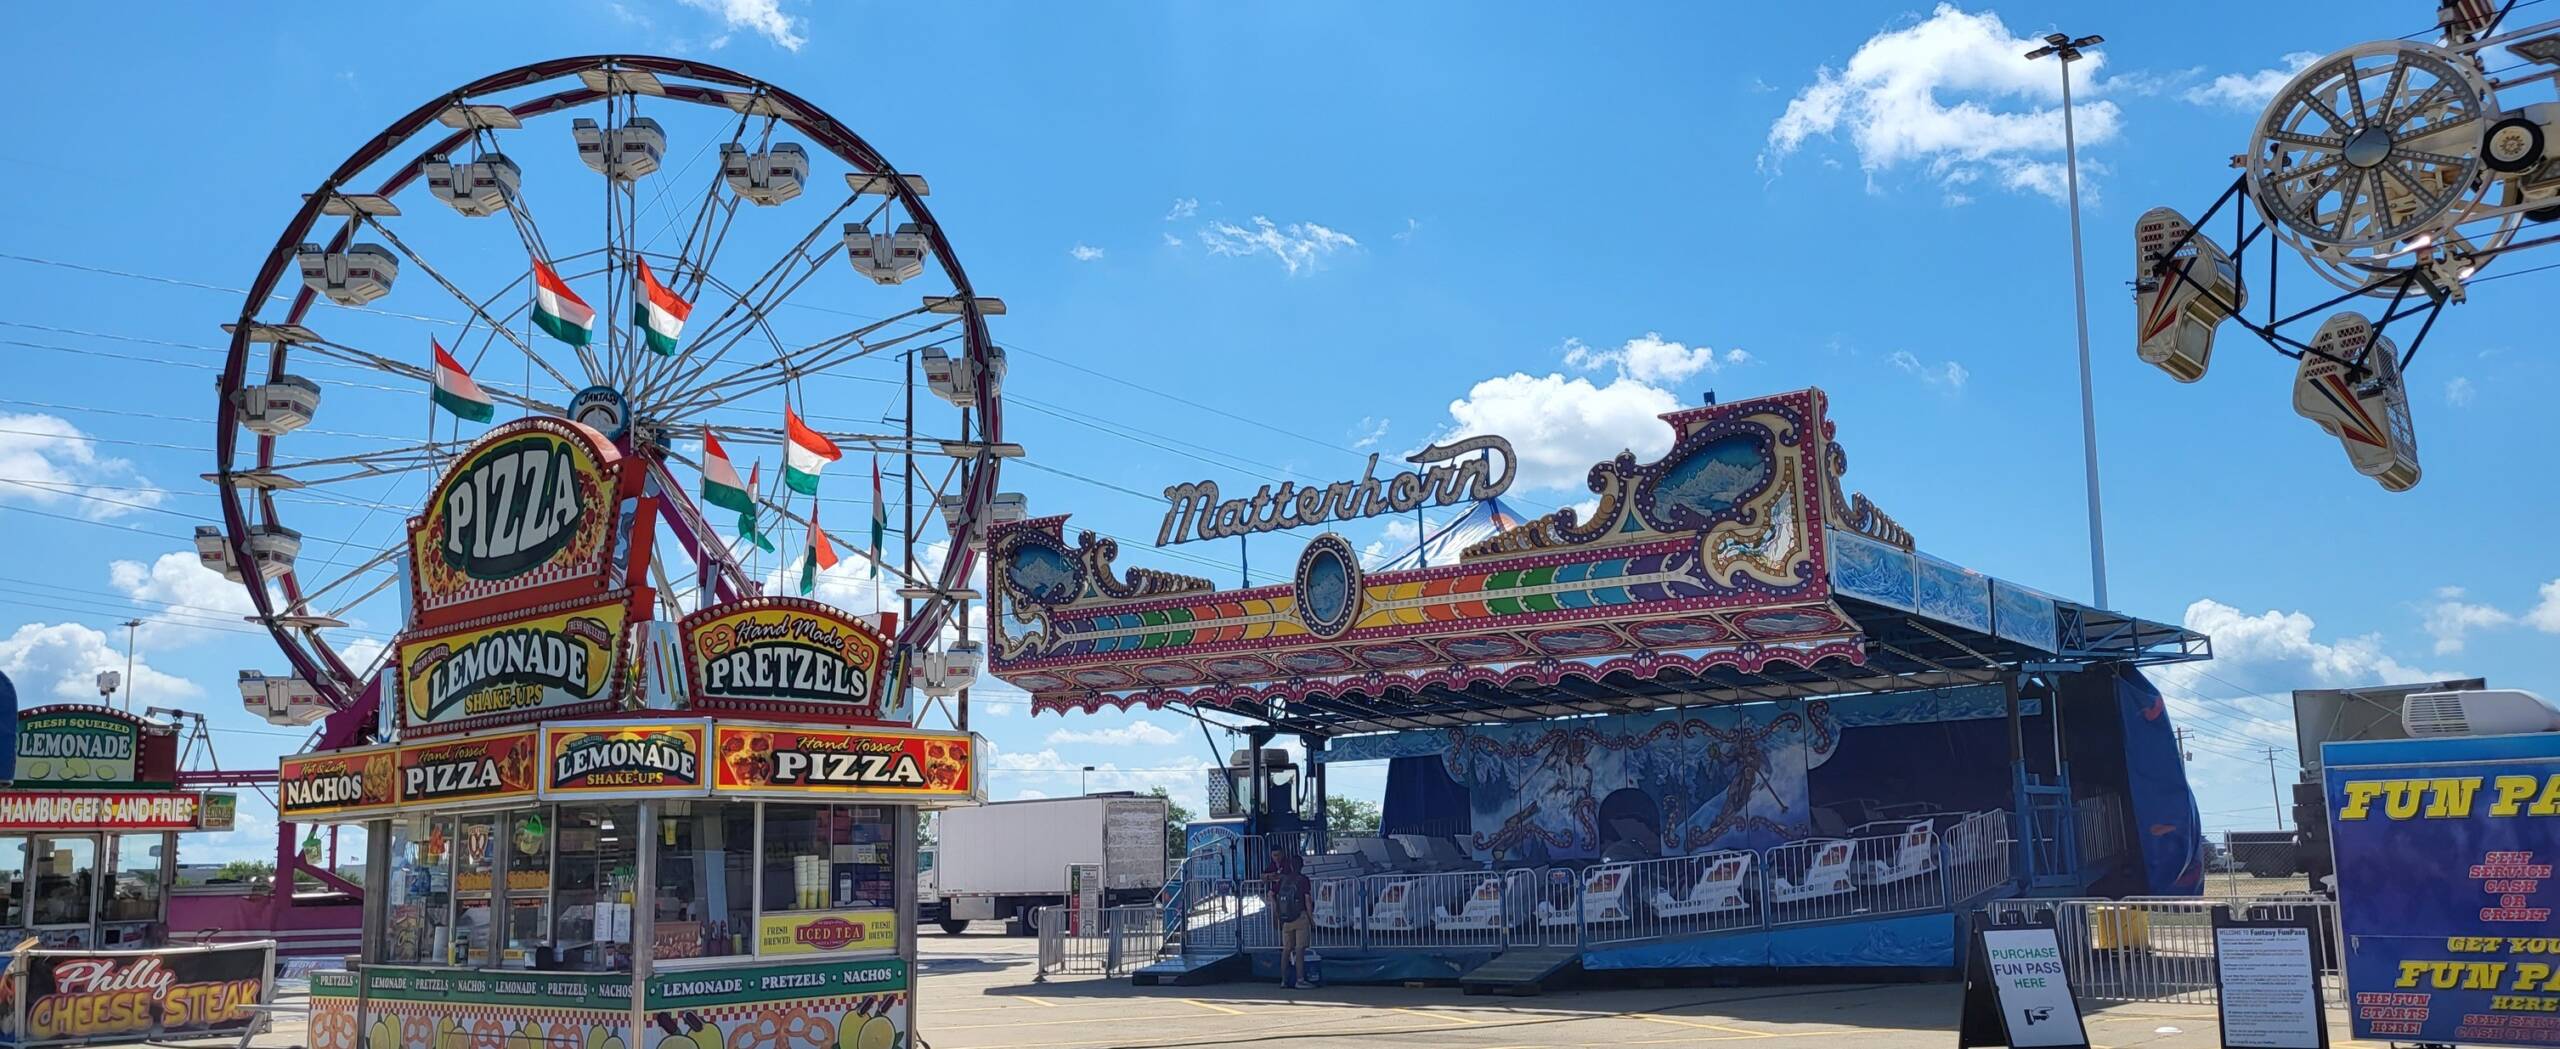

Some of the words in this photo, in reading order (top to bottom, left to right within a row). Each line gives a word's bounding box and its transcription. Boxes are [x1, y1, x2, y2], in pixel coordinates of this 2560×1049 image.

[433, 153, 446, 161] 10
[1155, 434, 1517, 548] Matterhorn
[449, 450, 579, 558] PIZZA
[735, 615, 790, 643] Hand
[791, 617, 846, 650] Made
[431, 634, 586, 710] LEMONADE
[712, 646, 867, 698] PRETZELS
[465, 683, 544, 714] SHAKE-UPS
[27, 719, 66, 731] FRESH
[69, 718, 130, 733] SQUEEZED
[20, 733, 131, 759] LEMONADE
[796, 736, 851, 751] Hand
[855, 738, 904, 752] Tossed
[418, 747, 452, 763] Hand
[452, 743, 489, 758] Tossed
[558, 743, 695, 781] LEMONADE
[775, 752, 923, 784] PIZZA
[406, 759, 502, 795] PIZZA
[586, 772, 664, 785] SHAKE-UPS
[286, 774, 362, 806] NACHOS
[2340, 776, 2484, 820] FUN
[0, 796, 112, 823] HAMBURGERS
[115, 797, 150, 823] AND
[152, 796, 193, 823] FRIES
[2485, 852, 2533, 865] SELF
[2469, 865, 2552, 878] SERVICE
[2485, 880, 2538, 893] CASH
[2501, 894, 2526, 908] OR
[2480, 907, 2551, 921] CREDIT
[767, 926, 788, 935] FRESH
[871, 921, 891, 930] FRESH
[2250, 928, 2276, 937] Fantasy
[800, 928, 831, 940] ICED
[836, 927, 860, 939] TEA
[869, 931, 893, 941] BREWED
[764, 937, 790, 946] BREWED
[2447, 937, 2502, 953] GET
[1991, 947, 2057, 960] PURCHASE
[1994, 963, 2023, 976] FUN
[2026, 962, 2062, 975] PASS
[2395, 961, 2507, 990] FUN
[55, 957, 174, 1000] Philly
[320, 975, 353, 987] PRETZELS
[663, 978, 743, 997] LEMONADE
[761, 972, 826, 990] PRETZELS
[842, 968, 893, 984] NACHOS
[2014, 977, 2047, 989] HERE
[371, 977, 407, 990] LEMONADE
[415, 979, 449, 991] PRETZELS
[457, 980, 486, 993] NACHOS
[495, 981, 537, 995] LEMONADE
[547, 982, 588, 997] PRETZELS
[599, 984, 634, 998] NACHOS
[2357, 992, 2391, 1005] THE
[2391, 993, 2432, 1007] FUN
[2490, 995, 2559, 1011] HERE
[29, 991, 153, 1037] CHEESE
[161, 979, 261, 1027] STEAK
[2360, 1006, 2429, 1020] STARTS
[2370, 1020, 2423, 1035] HERE!
[2463, 1014, 2508, 1026] SELF
[2455, 1026, 2503, 1039] CASH
